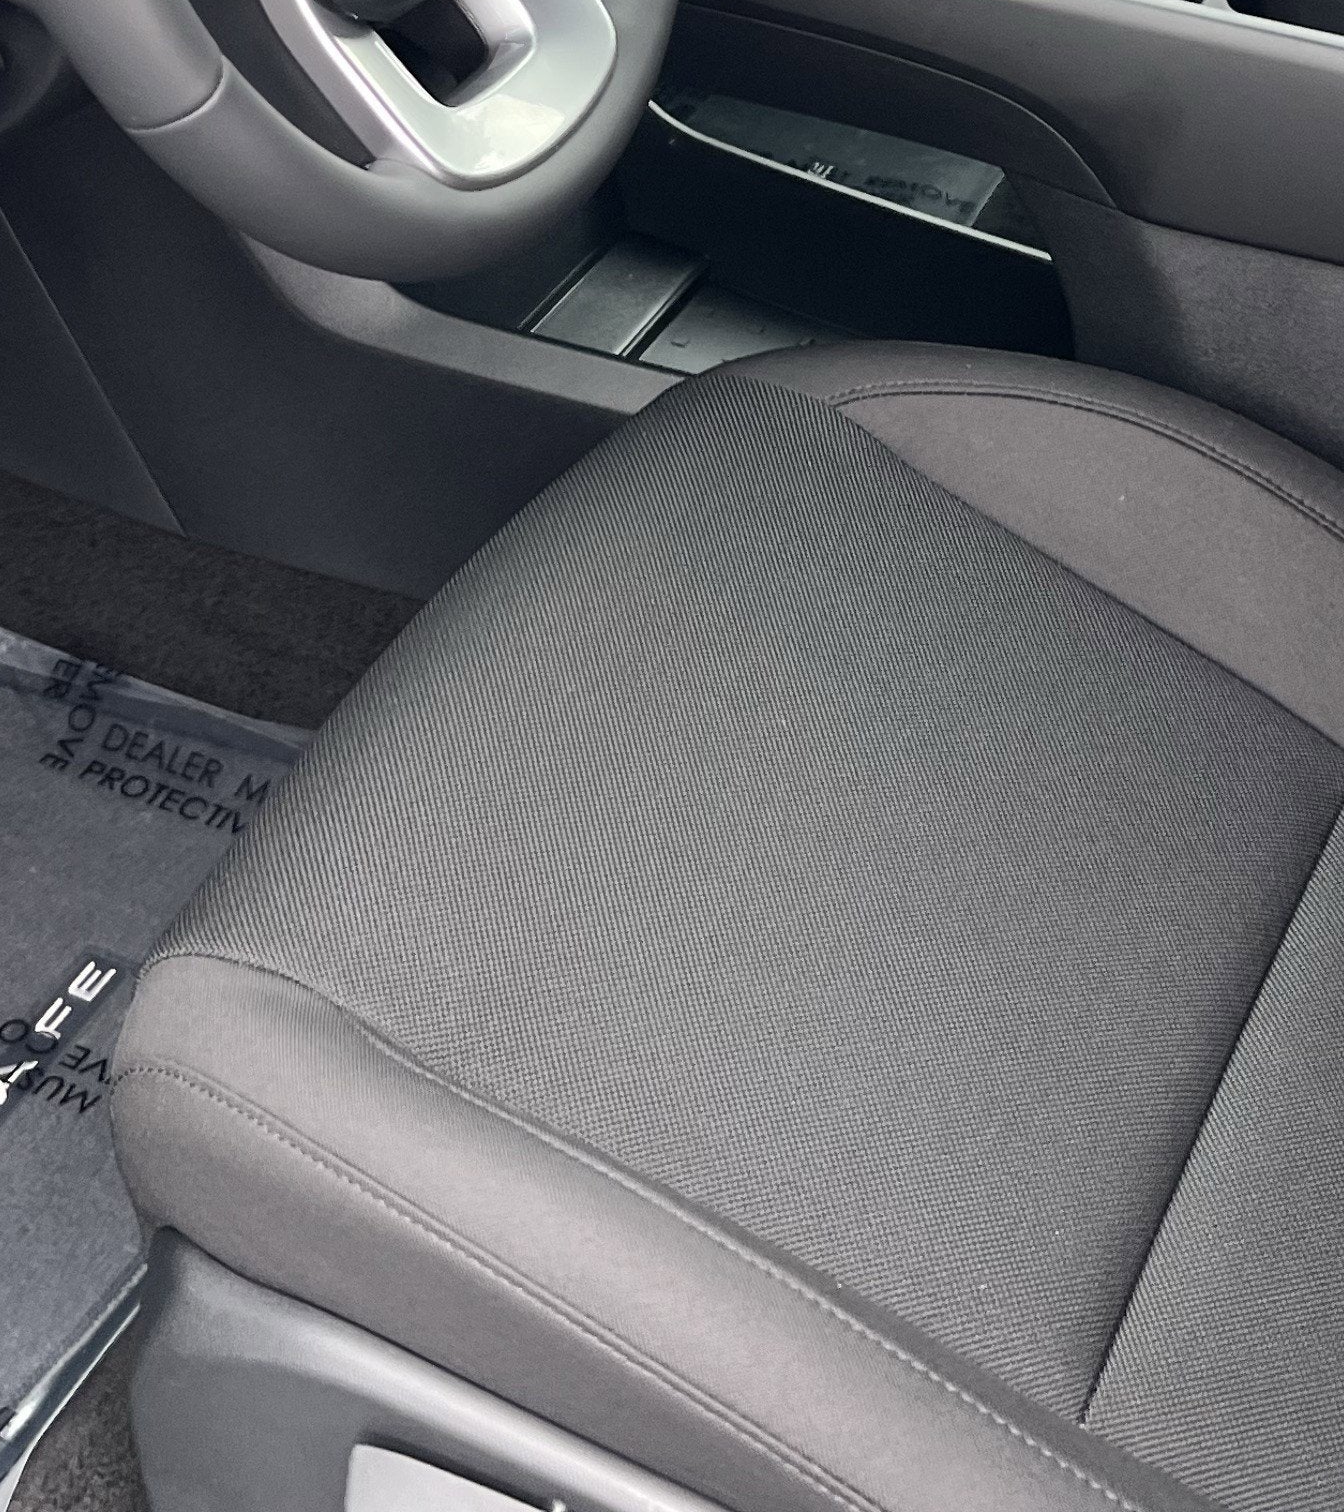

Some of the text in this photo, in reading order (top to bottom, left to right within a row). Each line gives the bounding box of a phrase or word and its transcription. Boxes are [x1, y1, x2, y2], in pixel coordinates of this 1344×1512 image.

[103, 722, 224, 789] DEALER
[79, 759, 248, 834] PROTECTIV
[32, 958, 120, 1040] FE
